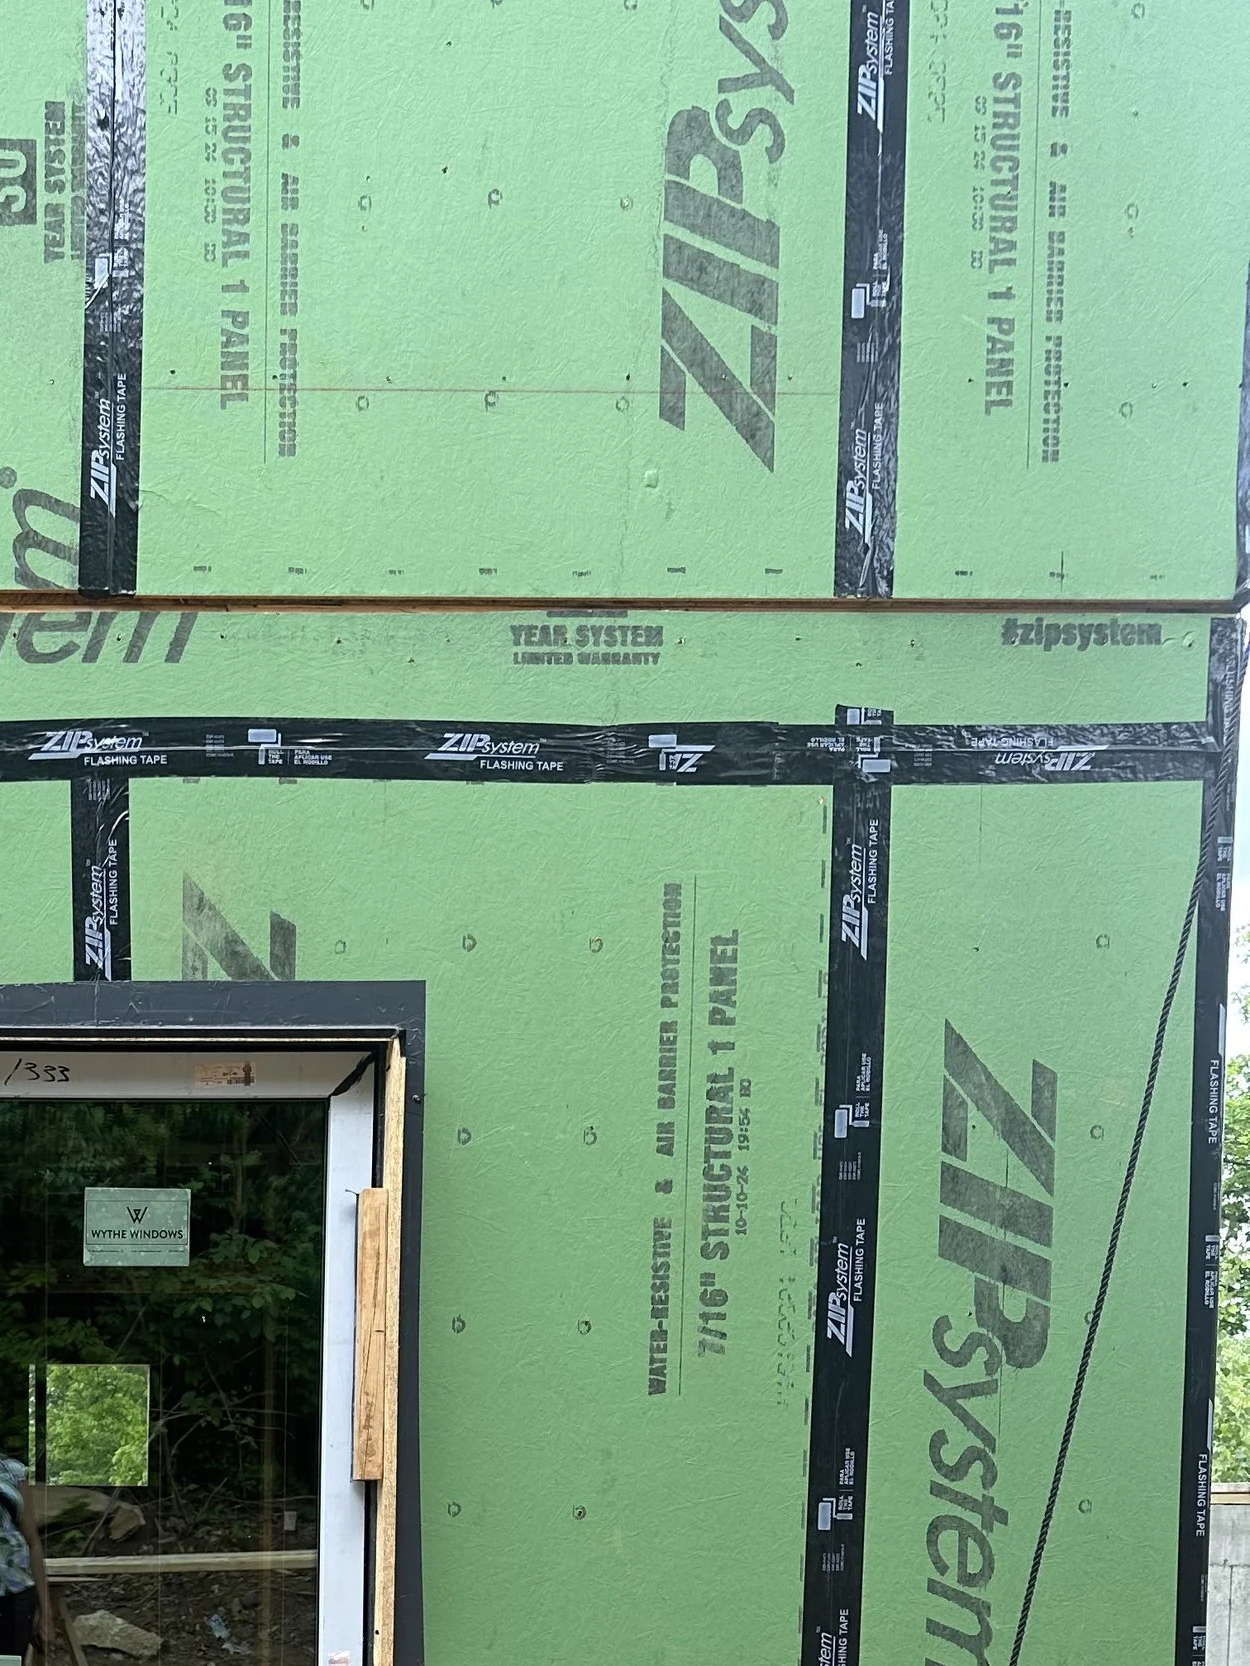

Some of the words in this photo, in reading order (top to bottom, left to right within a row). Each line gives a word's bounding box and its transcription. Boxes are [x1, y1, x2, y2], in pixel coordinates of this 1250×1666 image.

[857, 11, 881, 126] ZIPsystem
[884, 16, 894, 75] FLASHING
[44, 101, 66, 196] SYSTEM
[221, 63, 252, 268] STRUCTURAL
[988, 72, 1022, 274] STRUCTURAL
[281, 173, 299, 210] AIR
[1049, 181, 1067, 218] AIR
[44, 203, 65, 264] YEAR
[221, 279, 249, 293] 1
[280, 223, 298, 316] BARRIER
[987, 286, 1016, 300] 1
[1046, 231, 1065, 323] BARRIER
[220, 309, 249, 410] PANEL
[985, 316, 1015, 416] PANEL
[117, 373, 126, 404] TAPE
[278, 329, 297, 457] PROTECTION
[1042, 336, 1062, 462] PROTECTION
[116, 408, 126, 461] FLASHING
[873, 402, 883, 433] TAPE
[91, 398, 114, 512] ZIPsystem
[872, 437, 882, 489] FLASHING
[845, 428, 868, 541] ZIPsystem
[510, 625, 569, 647] YEAR
[575, 625, 664, 647] SYSTEM
[513, 652, 574, 665] LIMITED
[1002, 618, 1162, 651] #zipsystem
[83, 755, 138, 766] FLASHING
[140, 754, 168, 765] TAPE
[431, 733, 540, 757] ZIPsystem
[480, 760, 534, 771] FLASHING
[536, 761, 564, 772] TAPE
[110, 839, 118, 867] TAPE
[869, 819, 879, 849] TAPE
[110, 870, 118, 925] FLASHING
[841, 844, 863, 954] ZIPsystem
[867, 852, 876, 904] FLASHING
[85, 864, 108, 974] ZIPsystem
[661, 883, 682, 1008] PROTECTION
[708, 929, 739, 1025] PANEL
[657, 1020, 678, 1109] BARRIER
[707, 1040, 735, 1055] 1
[1210, 1059, 1220, 1112] FLASHING
[656, 1121, 675, 1157] AIR
[1207, 1114, 1217, 1145] TAPE
[654, 1178, 673, 1195] &
[700, 1067, 734, 1260] STRUCTURAL
[91, 1230, 127, 1239] WYTHE
[130, 1230, 184, 1239] WINDOWS
[855, 1218, 866, 1249] TAPE
[827, 1243, 851, 1351] ZIPsystem
[853, 1253, 862, 1302] FLASHING
[648, 1217, 672, 1395] WATER-RESISTIVE
[1198, 1454, 1207, 1507] FLASHING
[1196, 1510, 1205, 1537] TAPE
[838, 1608, 849, 1637] TAPE
